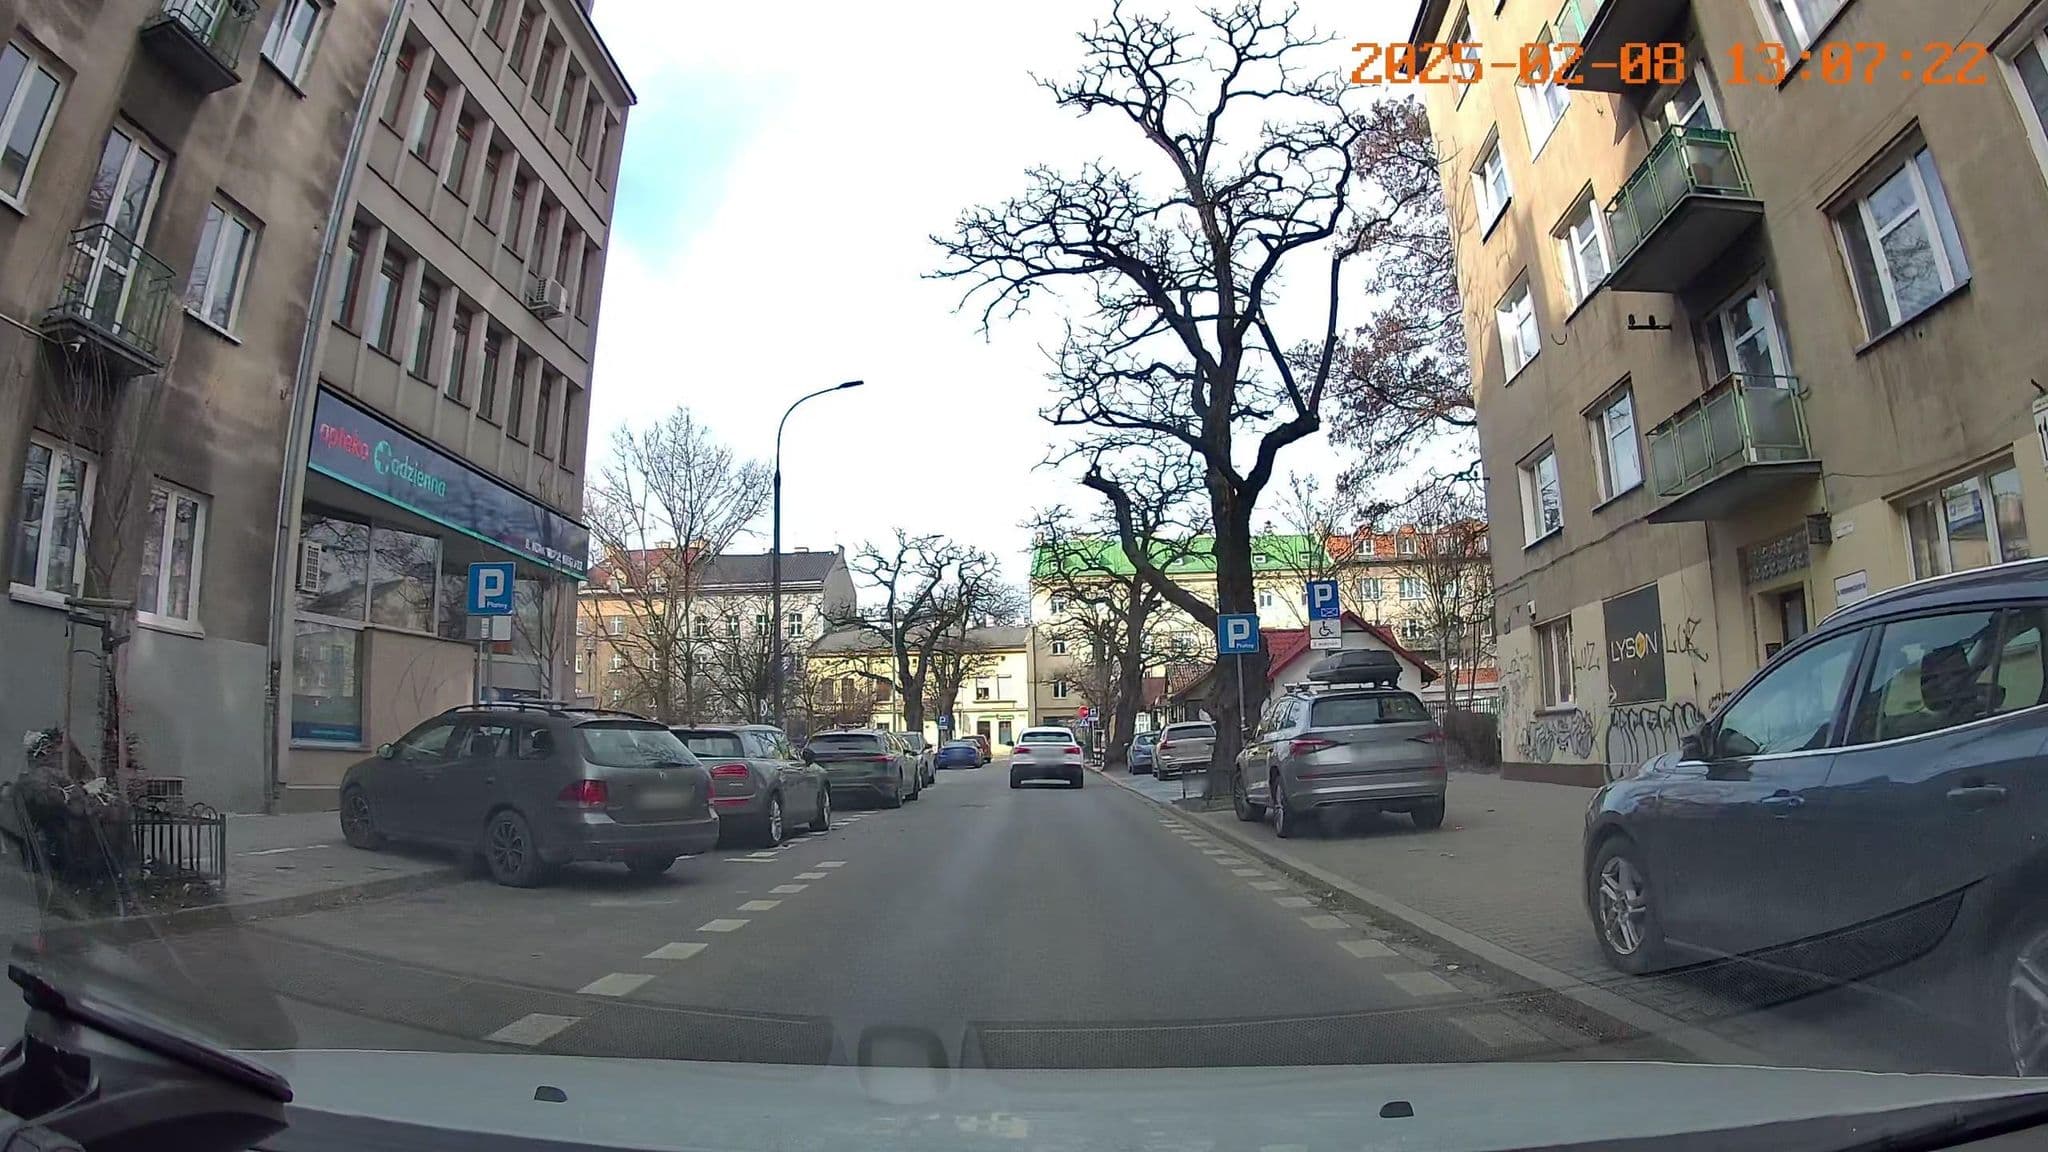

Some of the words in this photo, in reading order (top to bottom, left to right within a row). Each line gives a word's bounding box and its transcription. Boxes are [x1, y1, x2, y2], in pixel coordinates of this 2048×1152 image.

[478, 569, 505, 608] P
[1314, 583, 1332, 608] P
[1227, 619, 1250, 648] P
